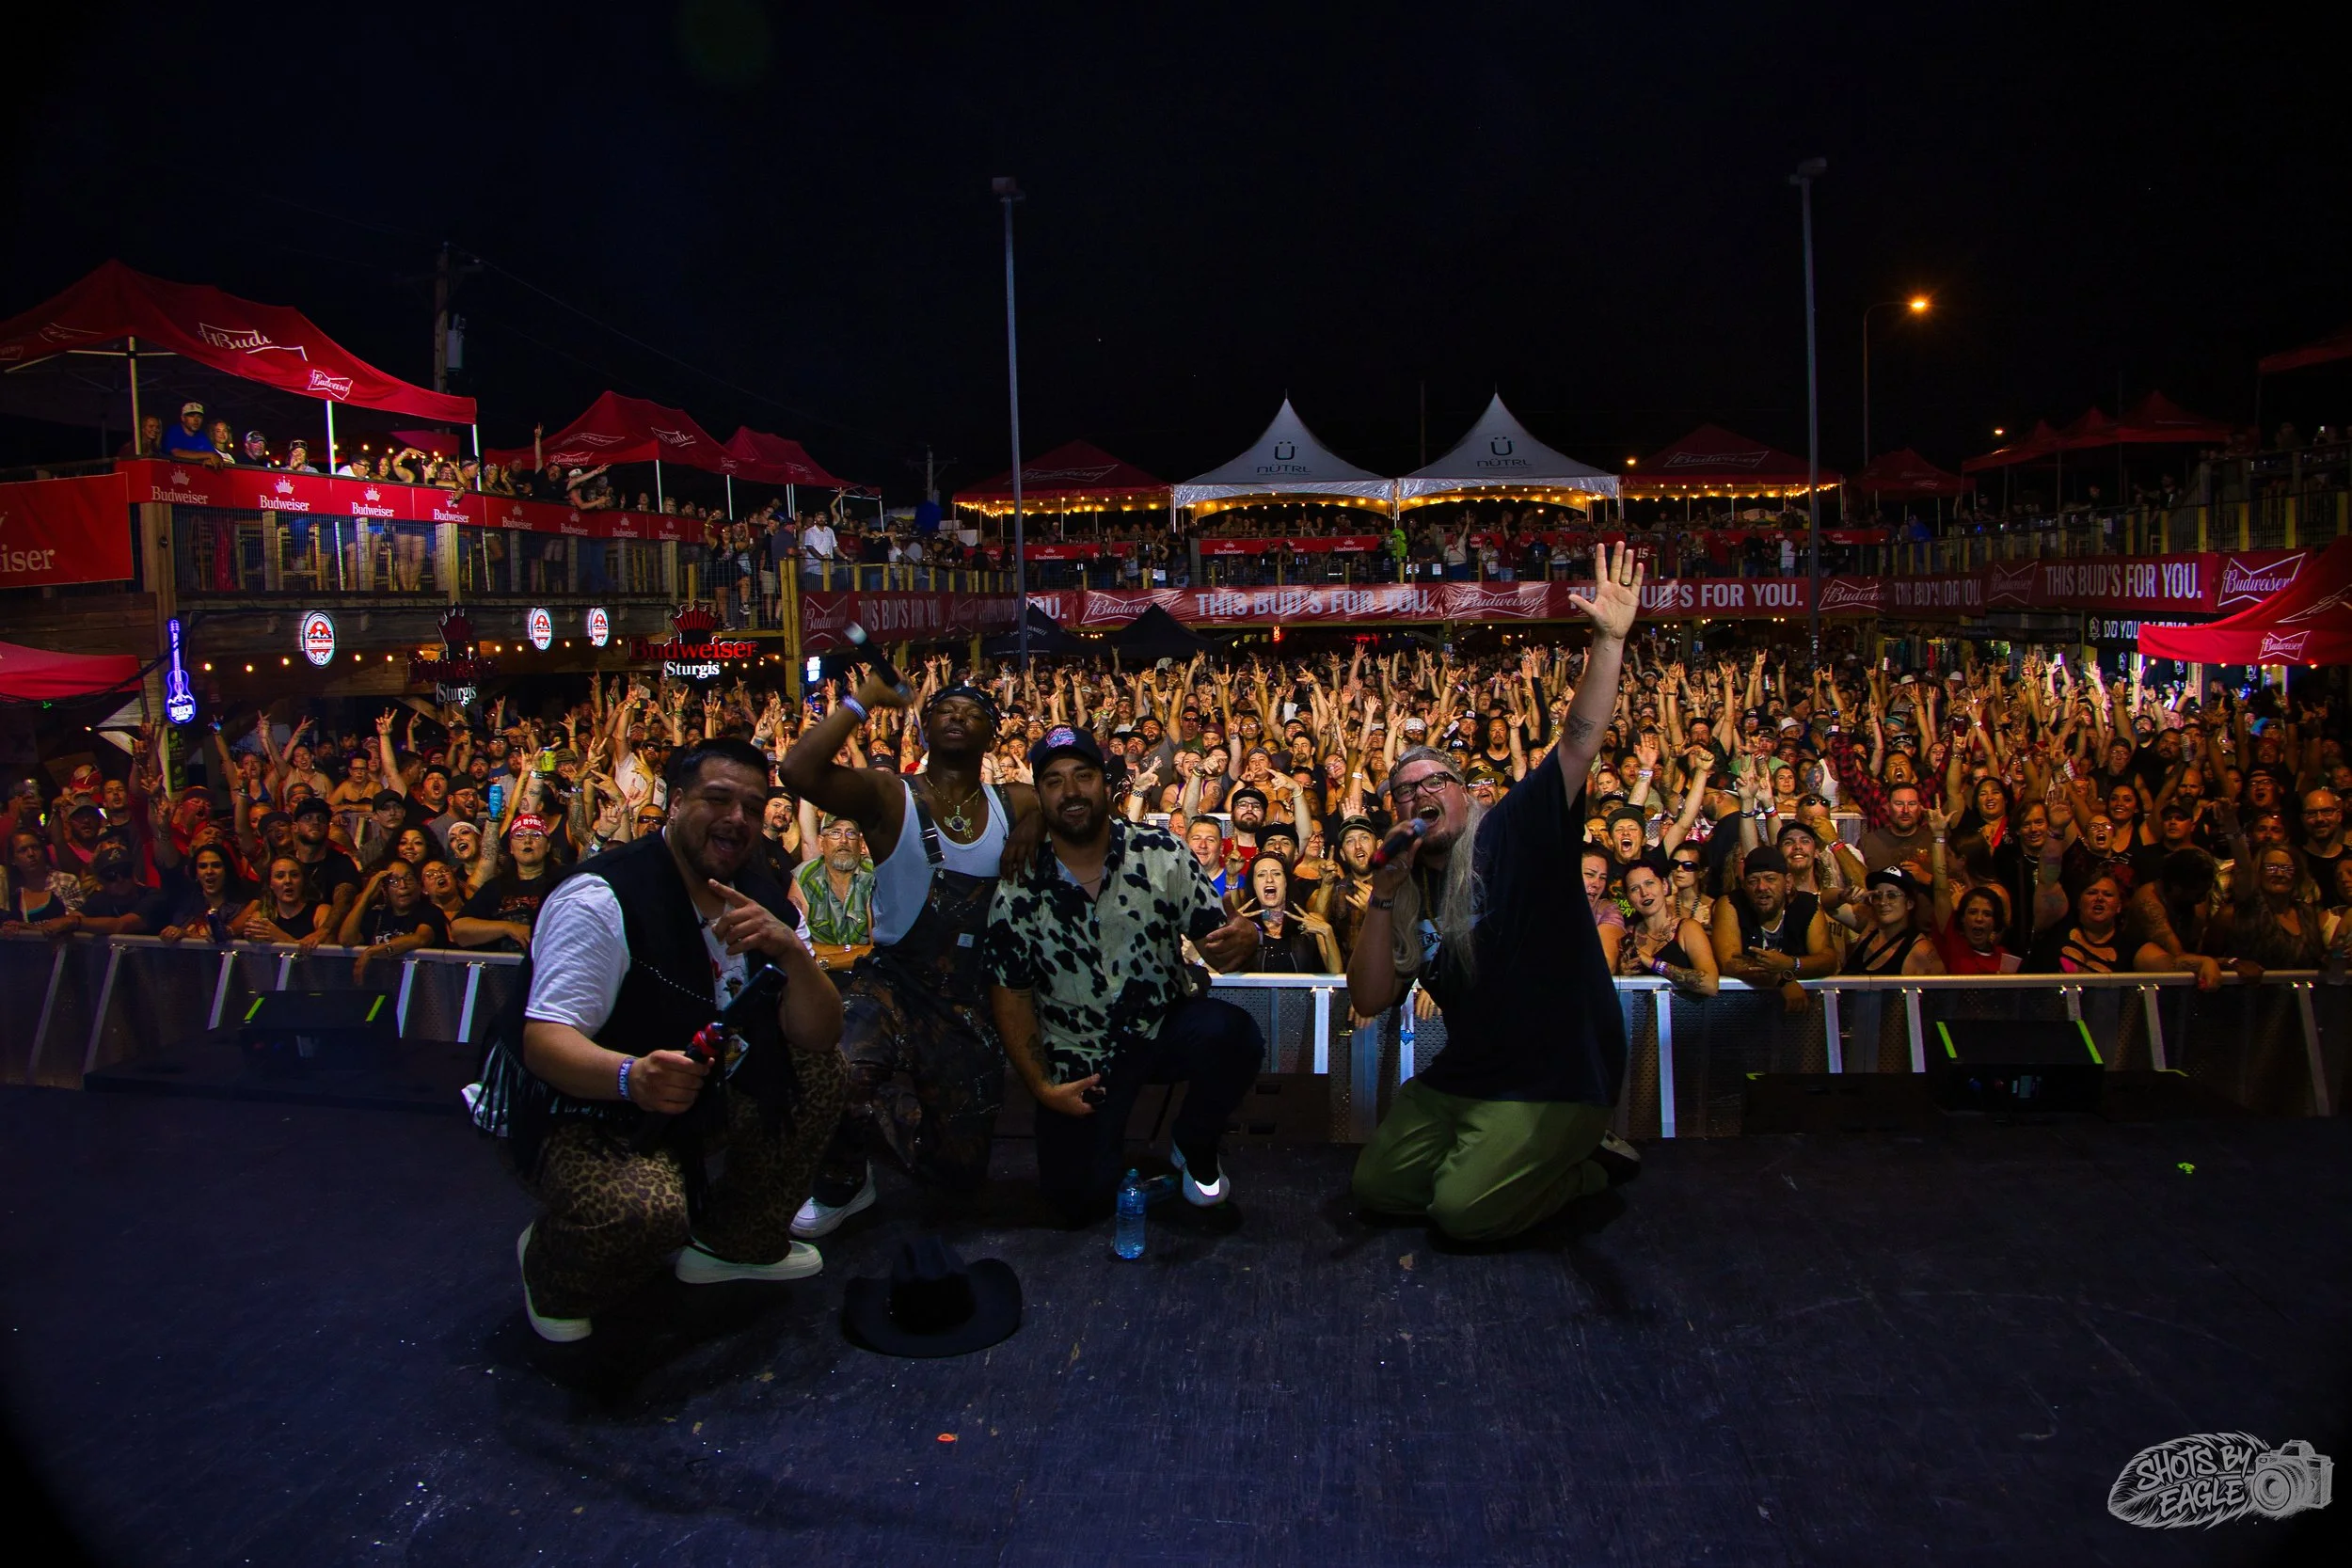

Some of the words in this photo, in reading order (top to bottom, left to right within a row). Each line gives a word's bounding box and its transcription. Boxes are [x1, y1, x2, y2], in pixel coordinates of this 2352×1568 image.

[1275, 440, 1295, 461] Ü
[1491, 436, 1513, 456] Ü
[151, 485, 209, 505] Budweiser
[260, 495, 310, 512] Budweiser
[351, 502, 395, 517] Budweiser
[434, 509, 470, 524] Budweiser
[501, 516, 533, 531] Budweiser
[561, 522, 589, 536] Budweiser
[0, 544, 56, 573] iser
[2045, 566, 2074, 596] THIS
[2077, 564, 2122, 597] BUD'S
[2125, 564, 2156, 598] FOR
[2161, 562, 2202, 599] YOU.
[2224, 568, 2293, 594] Budweiser
[1196, 593, 1248, 617] THIS
[1254, 591, 1323, 616] BUD'S
[1329, 589, 1376, 613] FOR
[1385, 588, 1436, 612] YOU.
[1458, 592, 1545, 608] Budweiser
[1640, 584, 1694, 609] UD'S
[1700, 583, 1745, 607] FOR
[1753, 583, 1804, 607] YOU.
[2103, 620, 2118, 640] DO
[631, 636, 759, 659] Budweiser
[2261, 638, 2303, 652] Budweiser
[665, 660, 721, 679] Sturgis
[438, 681, 477, 706] Sturgis
